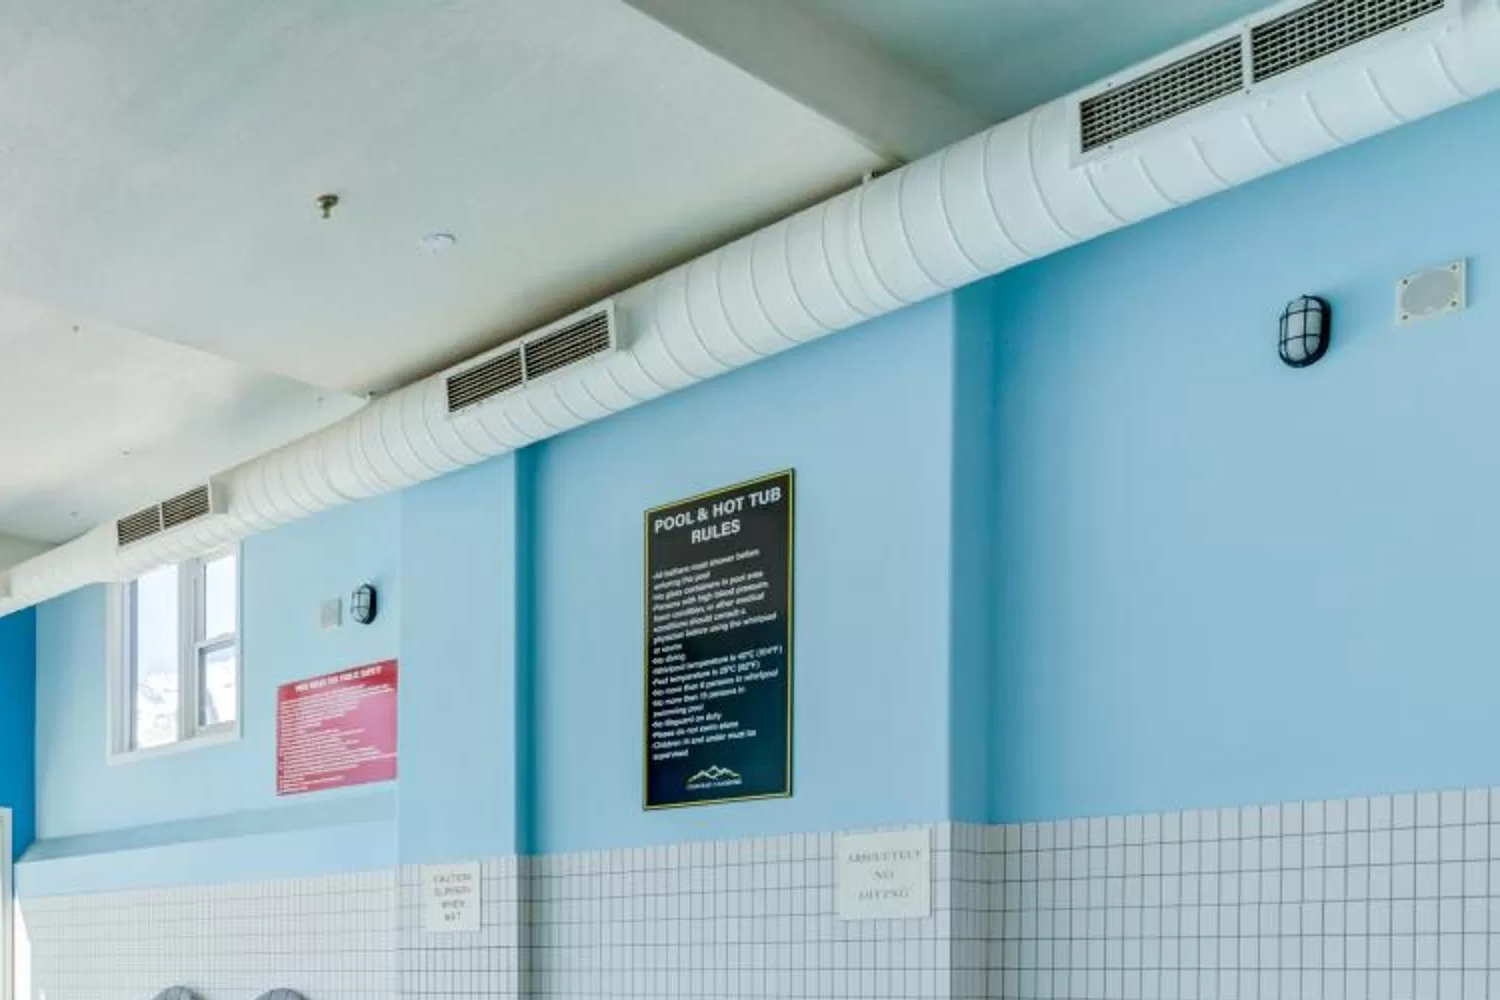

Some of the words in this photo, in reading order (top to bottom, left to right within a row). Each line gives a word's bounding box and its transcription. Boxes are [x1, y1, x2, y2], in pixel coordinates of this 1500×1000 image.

[654, 512, 695, 533] POOL
[697, 507, 708, 521] &
[712, 498, 744, 518] HOT
[748, 486, 782, 508] TUB
[691, 519, 741, 544] RULES
